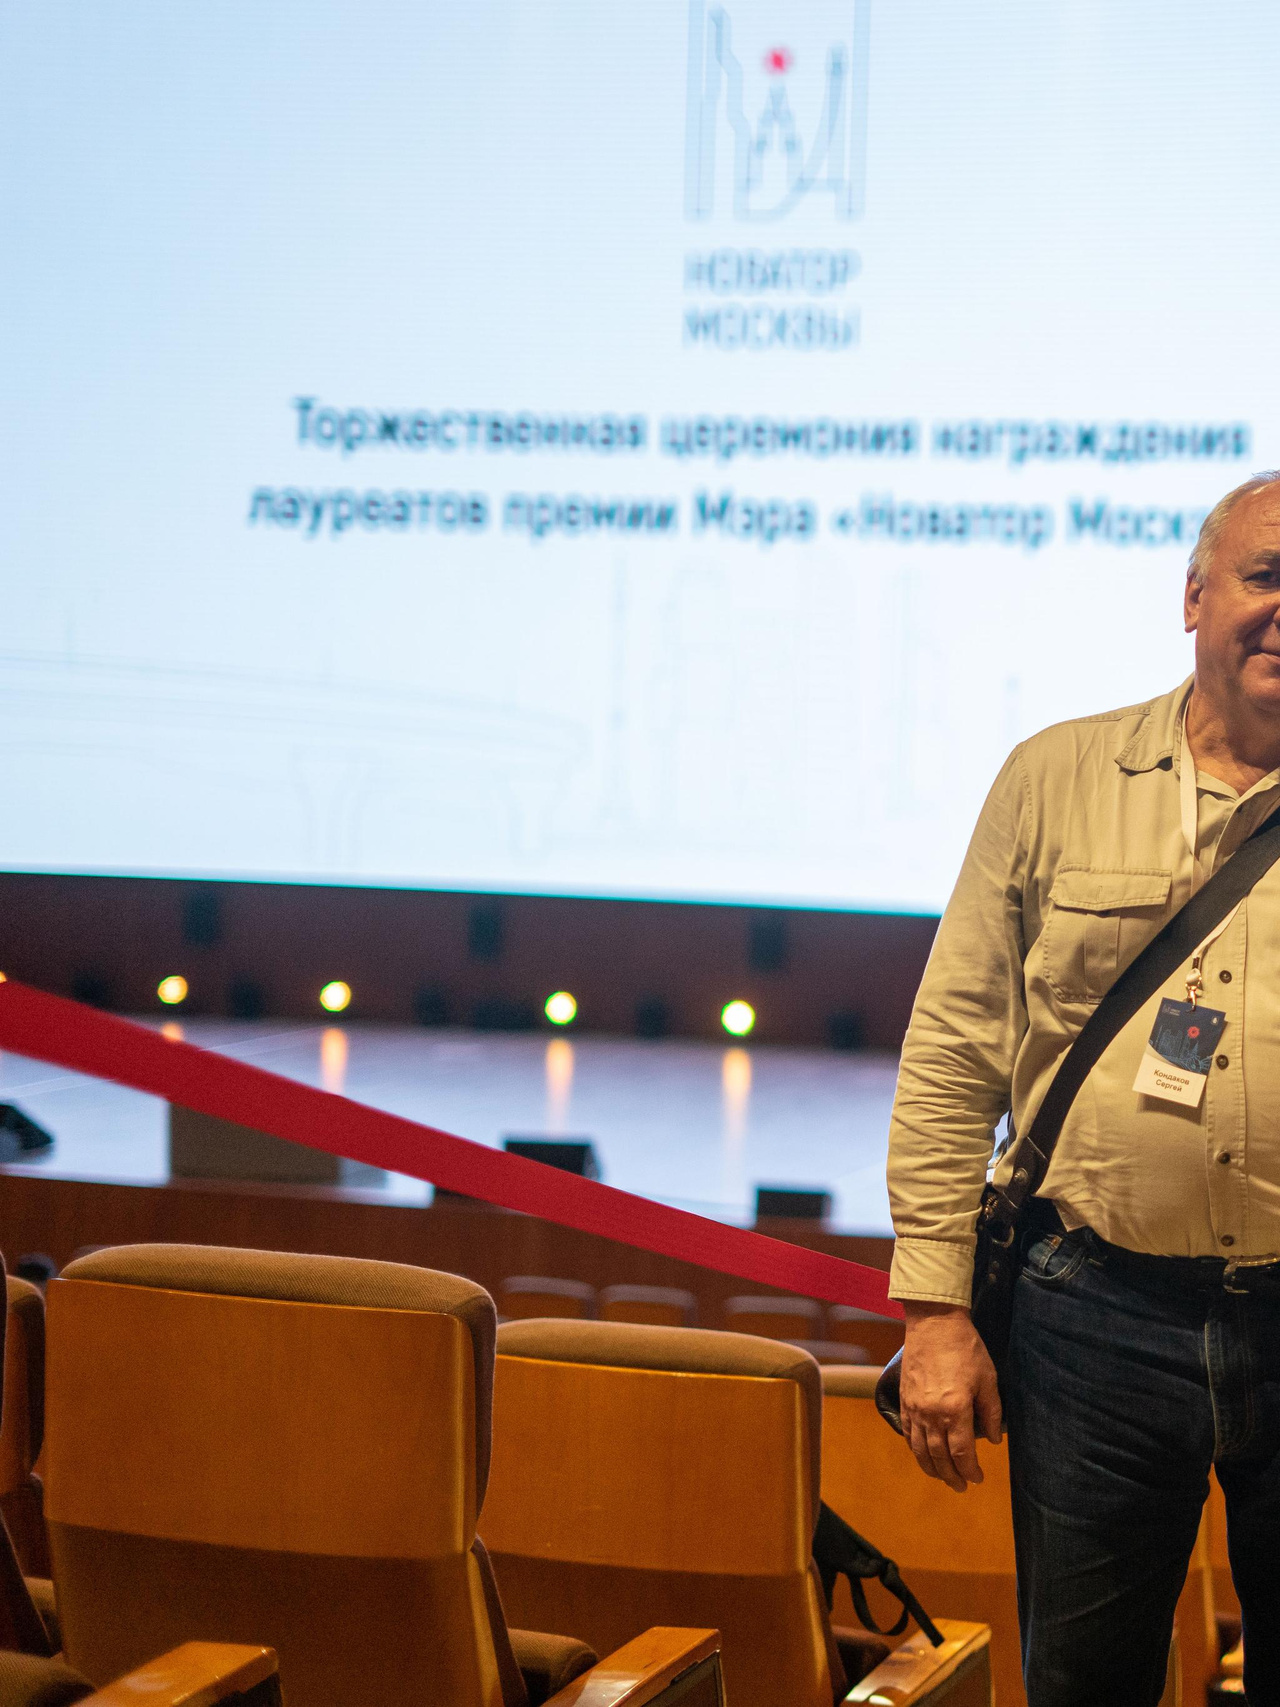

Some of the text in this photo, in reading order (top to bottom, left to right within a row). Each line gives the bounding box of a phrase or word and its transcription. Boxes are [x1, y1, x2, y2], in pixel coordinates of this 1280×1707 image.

[685, 249, 860, 294] НОВАТОР
[684, 304, 859, 350] МОСКВЫ
[291, 396, 1252, 470] Торжественная церемония награждения
[247, 487, 491, 540] лауреатов
[502, 492, 680, 543] премии
[692, 488, 818, 547] Мэра
[830, 493, 1055, 552] «Новатор
[1154, 1069, 1190, 1085] Кондаков
[1155, 1079, 1182, 1092] Сергей
